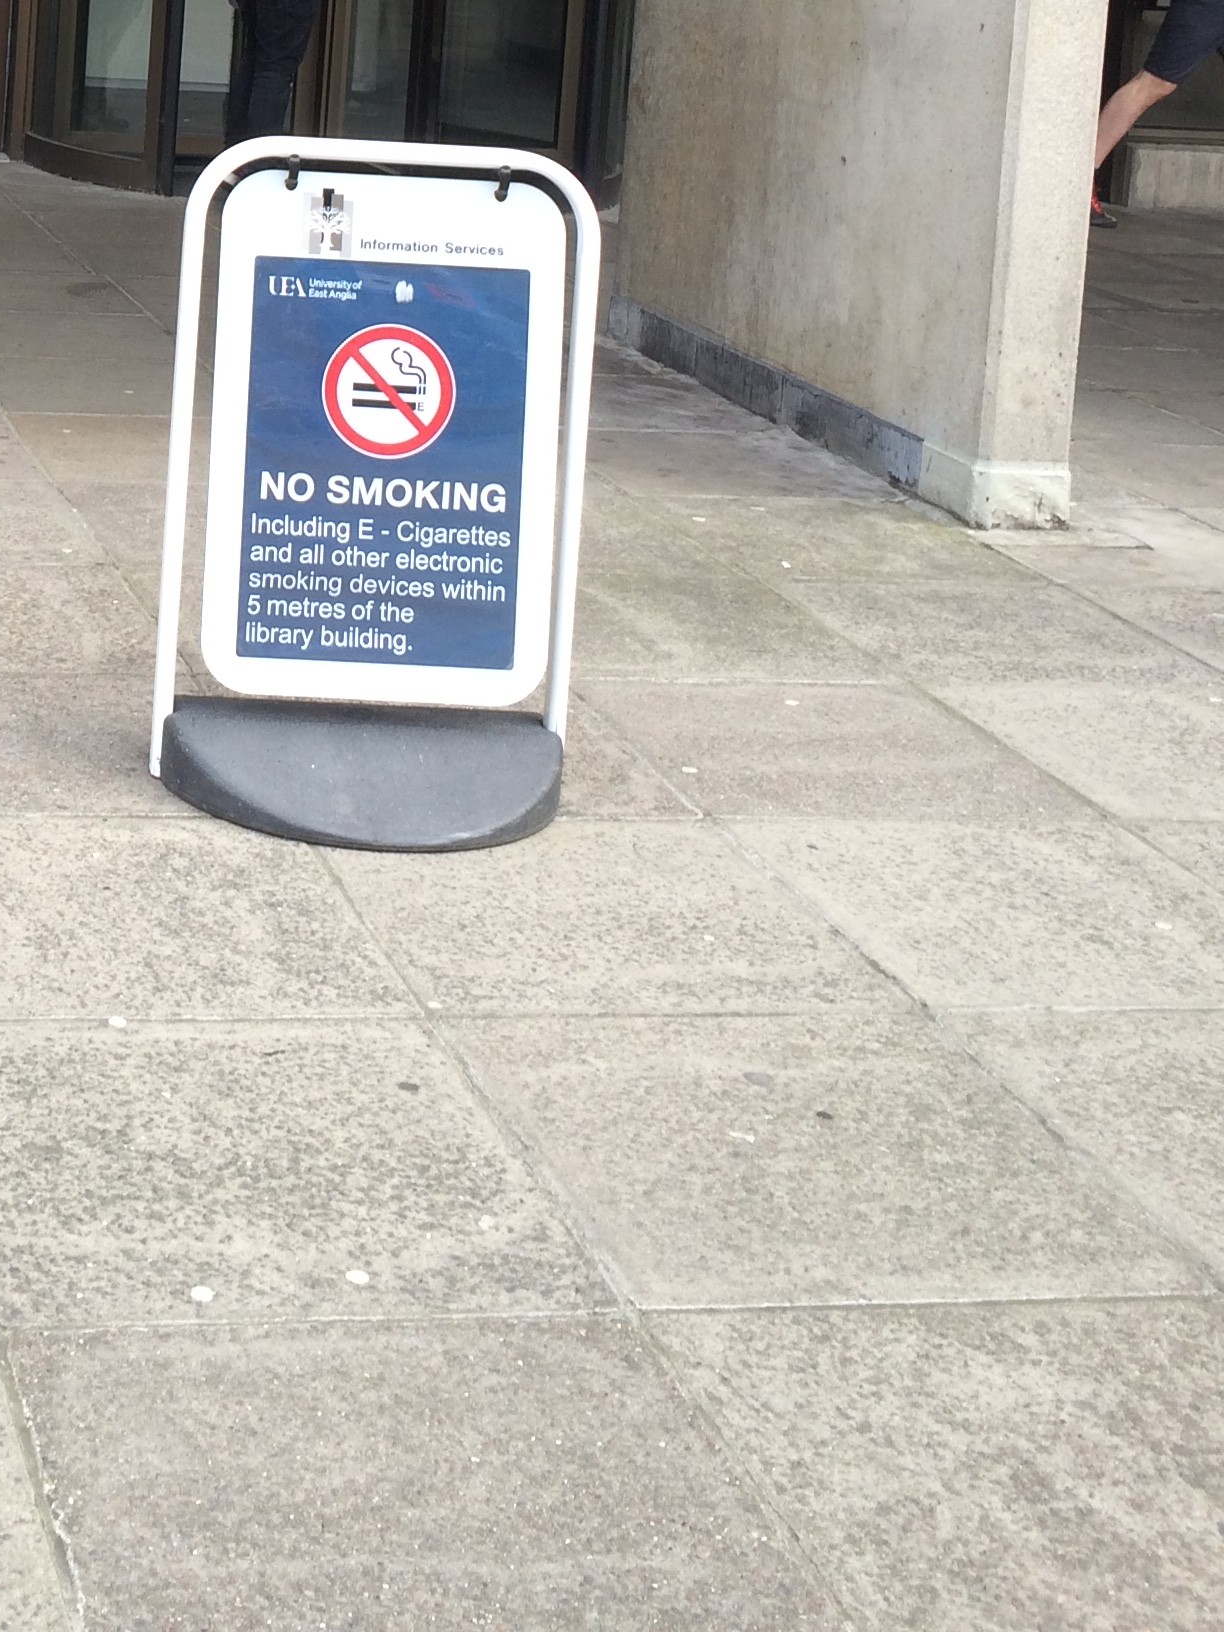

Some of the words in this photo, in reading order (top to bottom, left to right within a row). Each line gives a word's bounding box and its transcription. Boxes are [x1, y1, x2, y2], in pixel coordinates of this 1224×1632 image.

[360, 238, 438, 254] Information
[445, 242, 504, 256] Services
[268, 276, 307, 298] UEA
[308, 288, 327, 299] East
[328, 290, 358, 302] Anglia
[309, 278, 352, 290] University
[352, 280, 363, 290] of
[260, 470, 315, 502] NO
[326, 475, 506, 513] SMOKING
[251, 513, 350, 544] Including
[358, 518, 374, 540] E
[396, 520, 511, 547] Cigarettes
[250, 542, 292, 564] and
[299, 544, 324, 565] all
[331, 546, 390, 568] other
[395, 548, 504, 574] electronic
[248, 571, 342, 597] smoking
[349, 574, 435, 598] devices
[442, 579, 506, 602] within
[246, 594, 261, 616] 5
[266, 597, 346, 619] metres
[351, 600, 375, 620] of
[379, 602, 414, 624] the
[245, 621, 314, 651] library
[320, 625, 414, 656] building.
